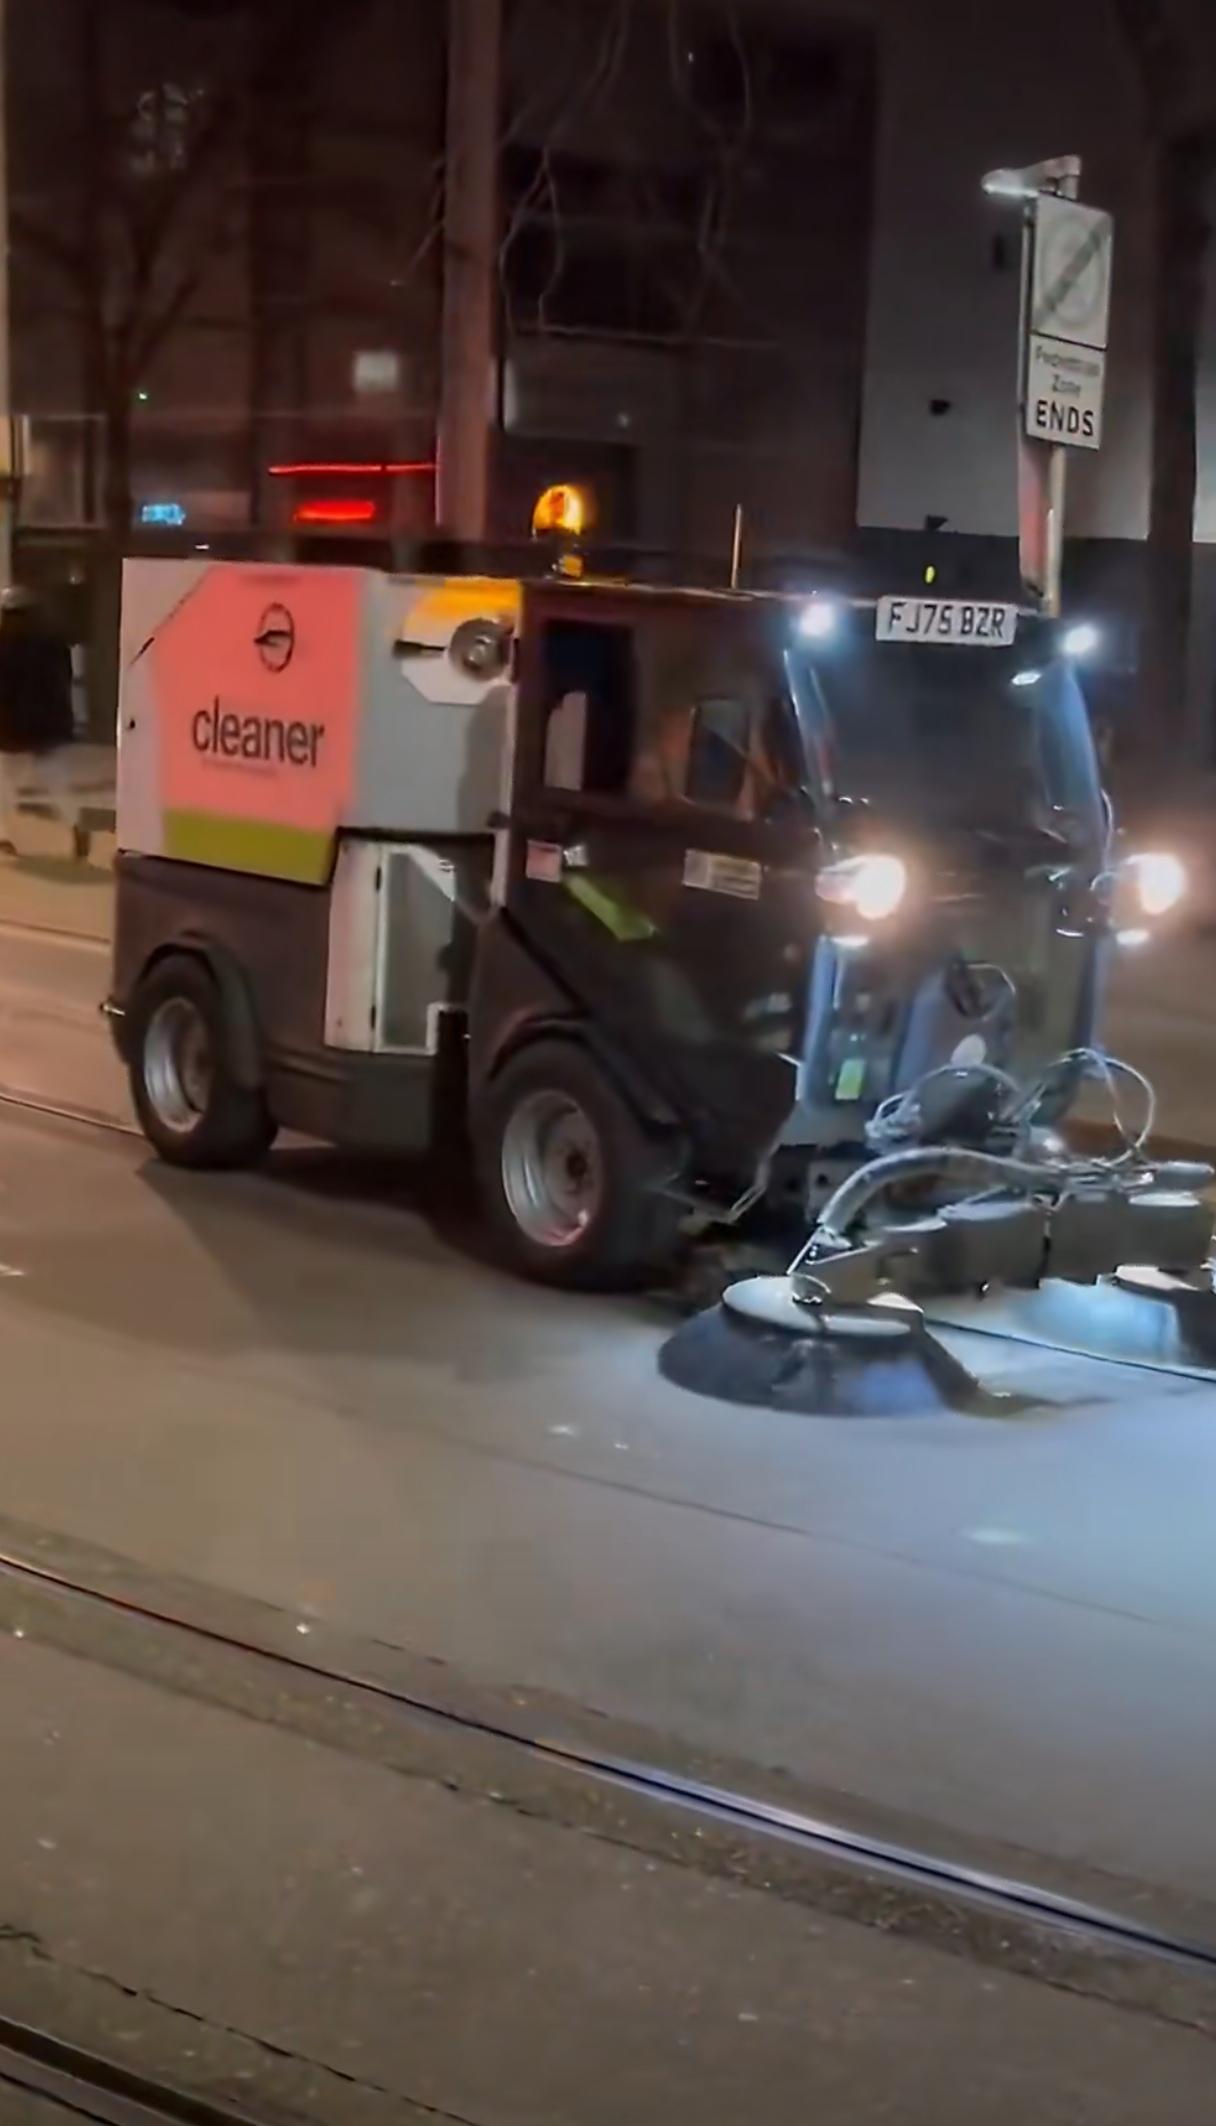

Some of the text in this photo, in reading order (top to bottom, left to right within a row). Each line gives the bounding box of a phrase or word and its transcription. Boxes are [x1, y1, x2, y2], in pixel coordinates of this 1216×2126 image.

[1036, 399, 1094, 437] ENDS
[889, 601, 1005, 638] FJ75 BZR
[192, 695, 325, 768] cleaner
